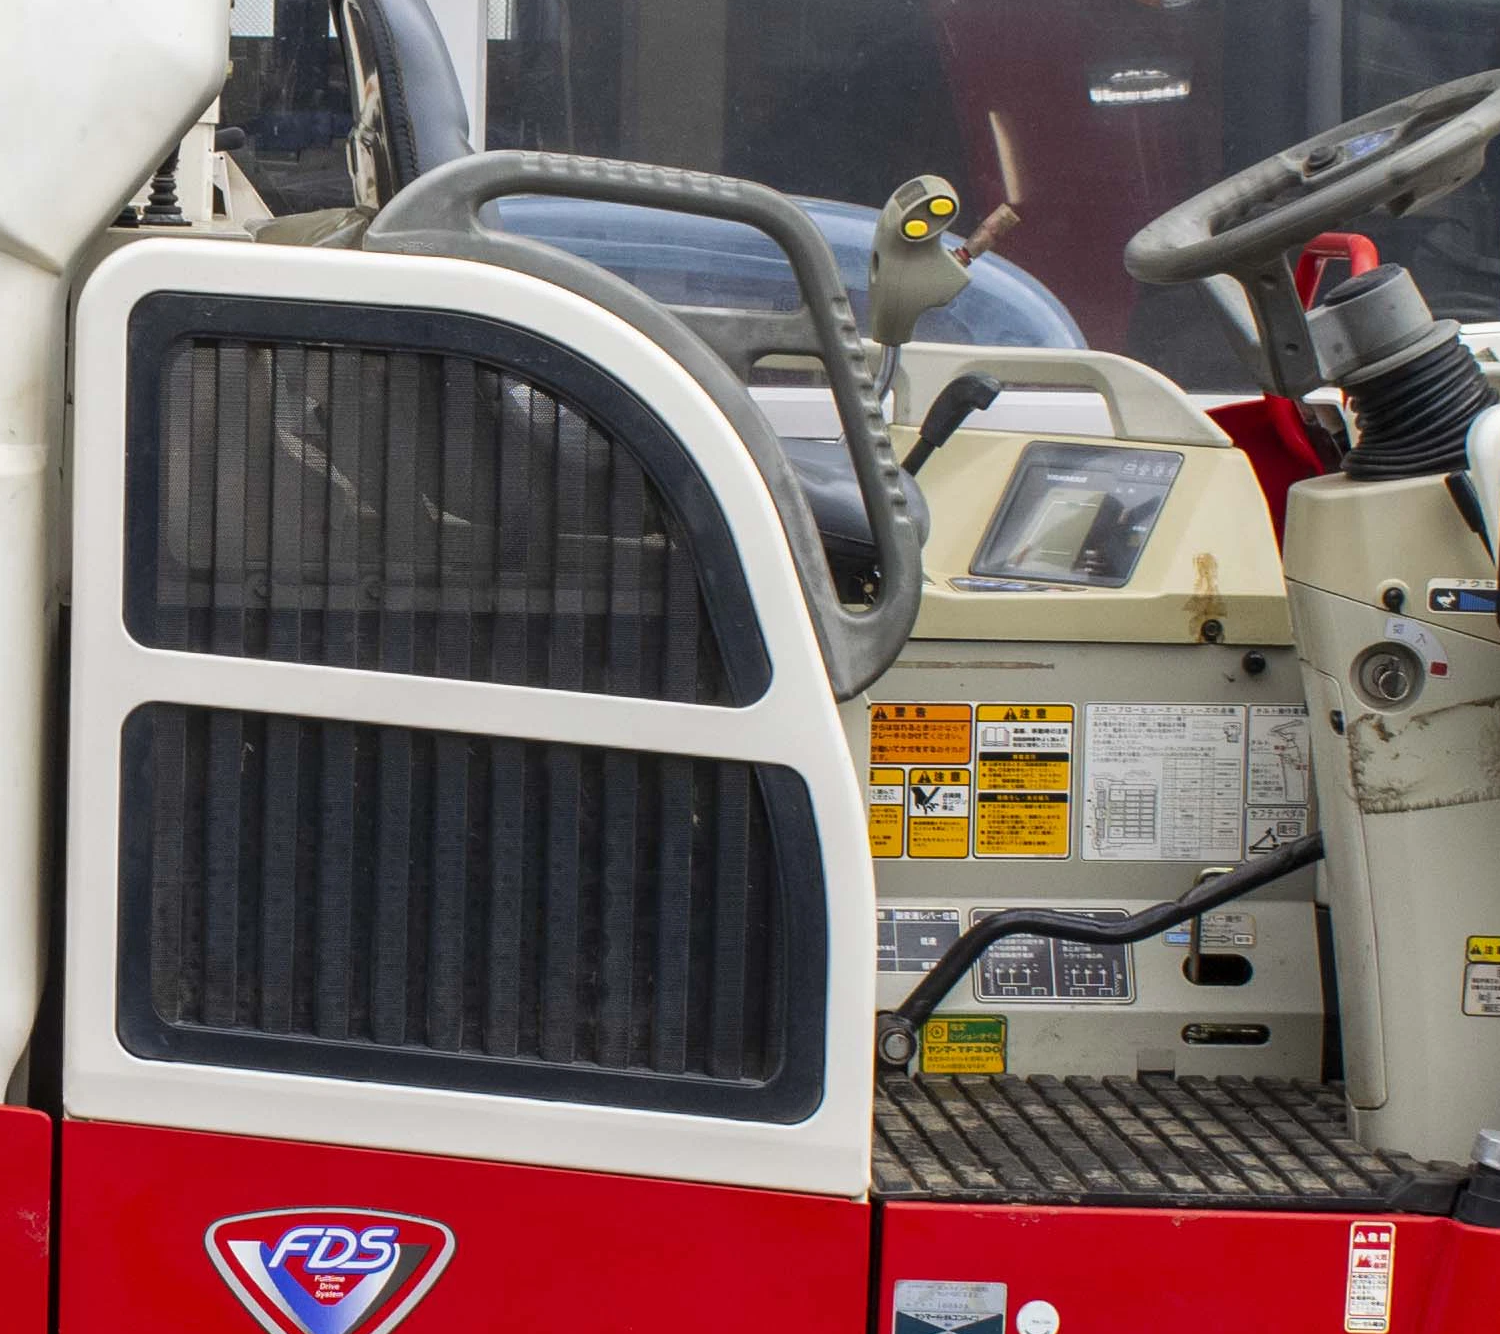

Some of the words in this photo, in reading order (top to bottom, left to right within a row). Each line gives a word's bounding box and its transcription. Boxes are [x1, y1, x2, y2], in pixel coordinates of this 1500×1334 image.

[1020, 708, 1047, 718] 注意
[934, 772, 961, 782] 注意
[267, 1226, 397, 1271] FDS
[319, 1282, 340, 1290] Drive
[315, 1290, 344, 1299] System
